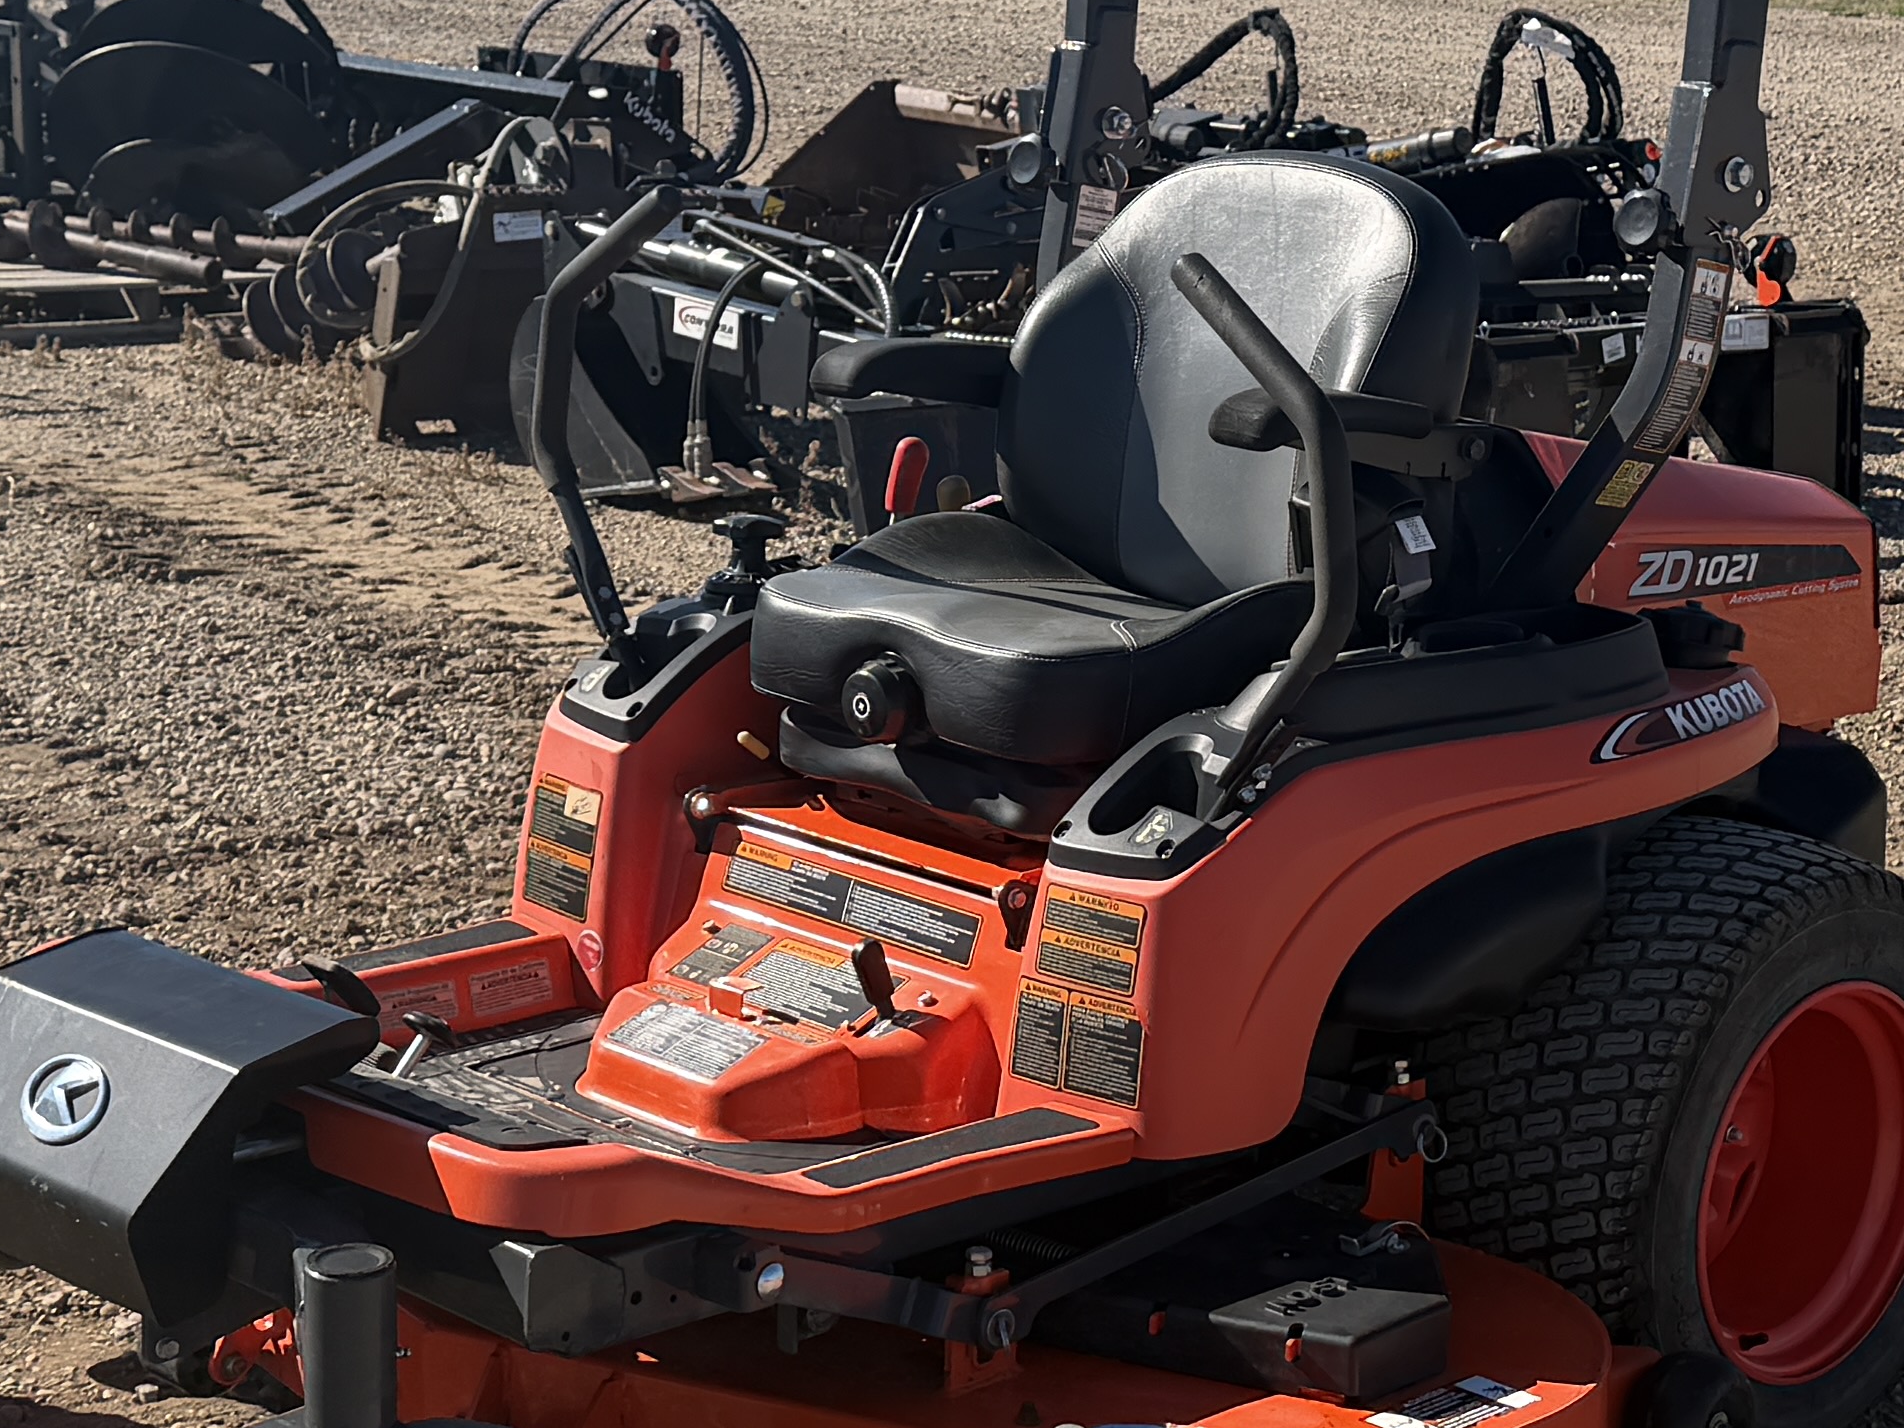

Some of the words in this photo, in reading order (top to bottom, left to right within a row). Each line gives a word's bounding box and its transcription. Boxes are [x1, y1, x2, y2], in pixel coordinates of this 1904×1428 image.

[623, 90, 676, 144] Kubota
[1628, 550, 1694, 597] ZD
[1695, 553, 1760, 586] 1021
[1728, 588, 1789, 605] Aerodynamic
[1791, 582, 1826, 596] Cutting
[1827, 578, 1859, 591] System
[1664, 679, 1766, 740] KUBOTA
[1063, 936, 1121, 958] ADVERTENCIA
